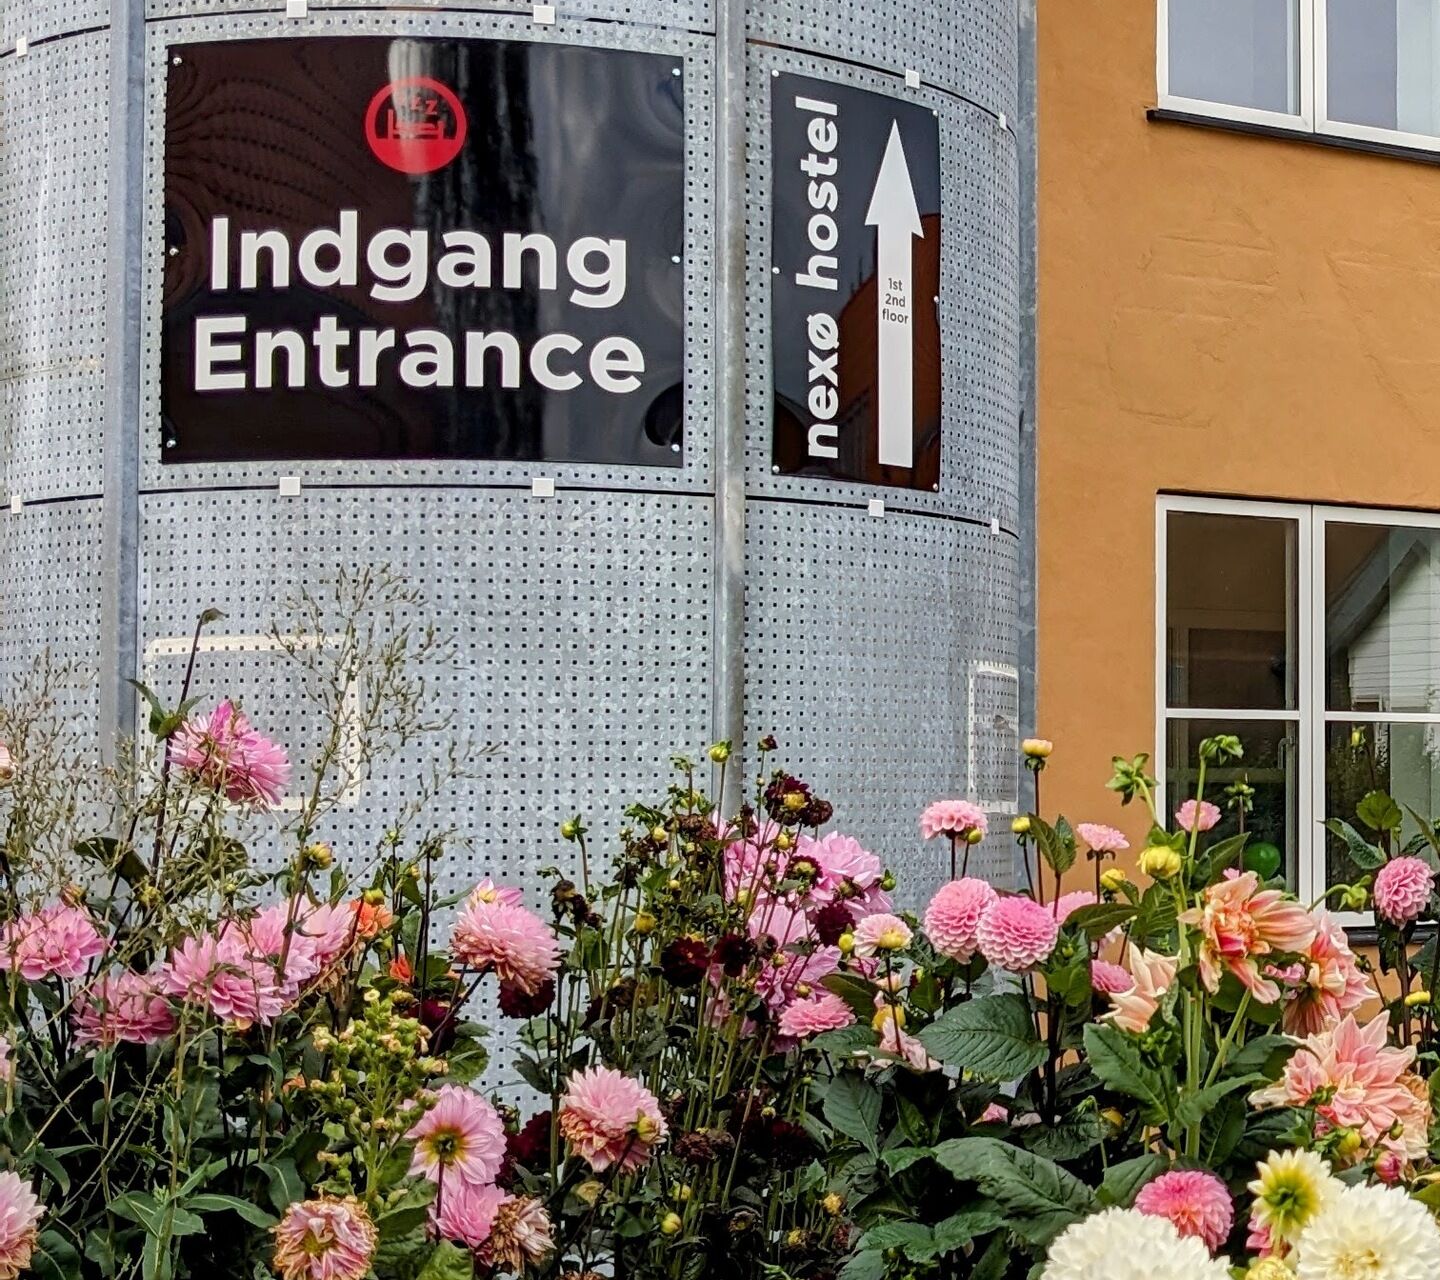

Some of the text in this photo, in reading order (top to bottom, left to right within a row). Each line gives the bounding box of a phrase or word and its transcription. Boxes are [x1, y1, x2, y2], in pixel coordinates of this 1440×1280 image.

[211, 210, 626, 308] Indgang
[795, 96, 840, 459] nexø hostel
[885, 293, 906, 308] 2nd
[888, 277, 903, 291] 1st
[882, 308, 909, 325] floor
[194, 316, 645, 393] Entrance
